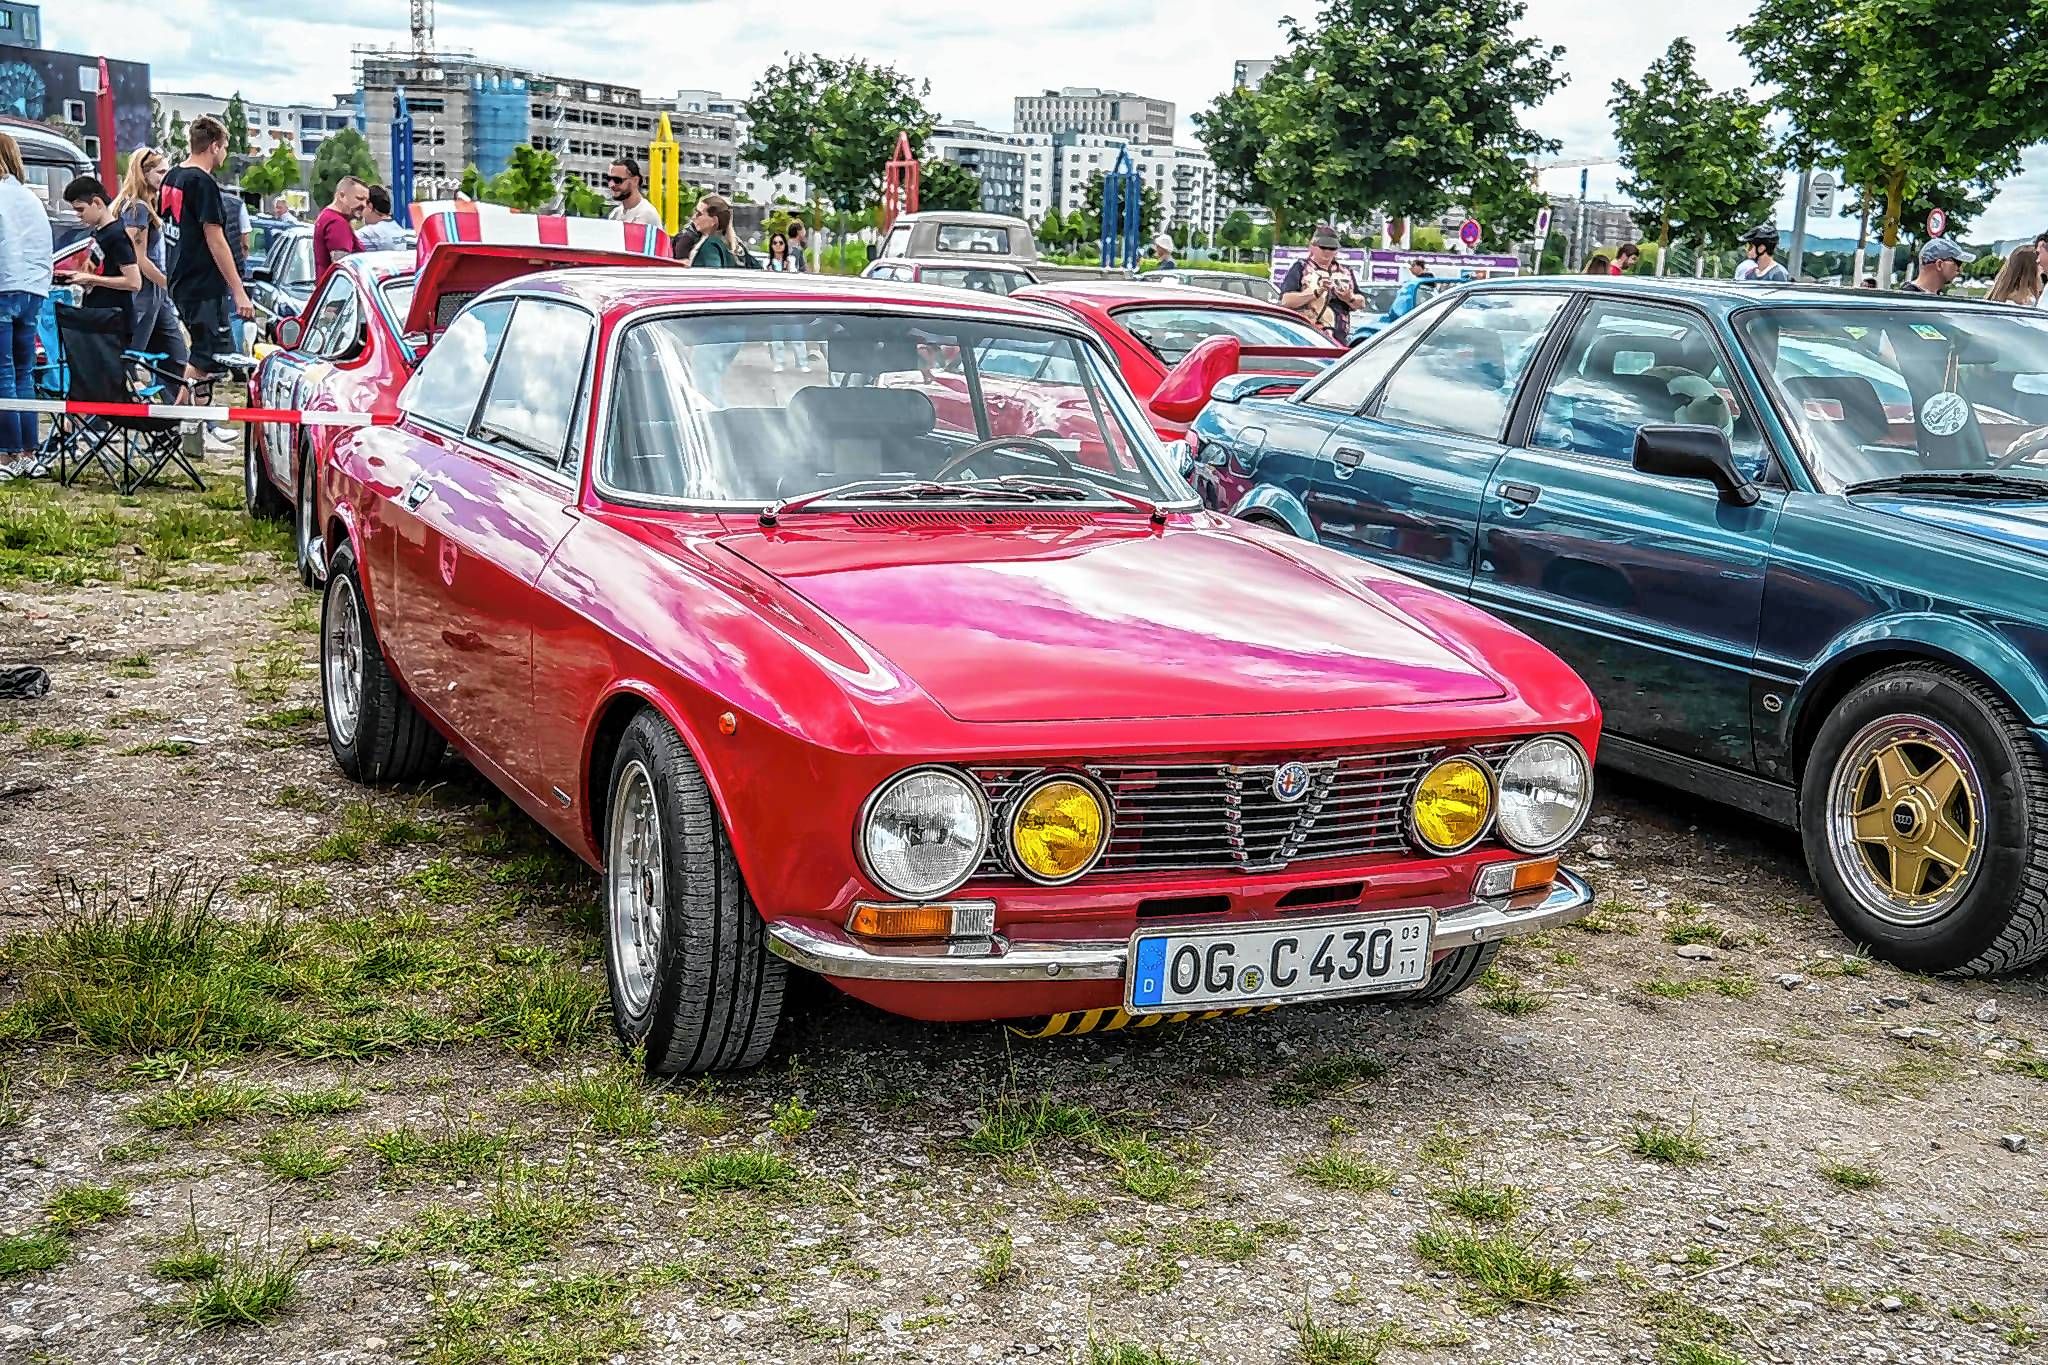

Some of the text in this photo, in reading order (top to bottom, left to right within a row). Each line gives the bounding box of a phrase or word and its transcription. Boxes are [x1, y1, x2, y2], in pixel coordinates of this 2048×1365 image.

[1400, 926, 1420, 941] 03
[1169, 928, 1393, 995] OG C 430
[1399, 959, 1416, 975] 11
[1143, 978, 1154, 993] D
